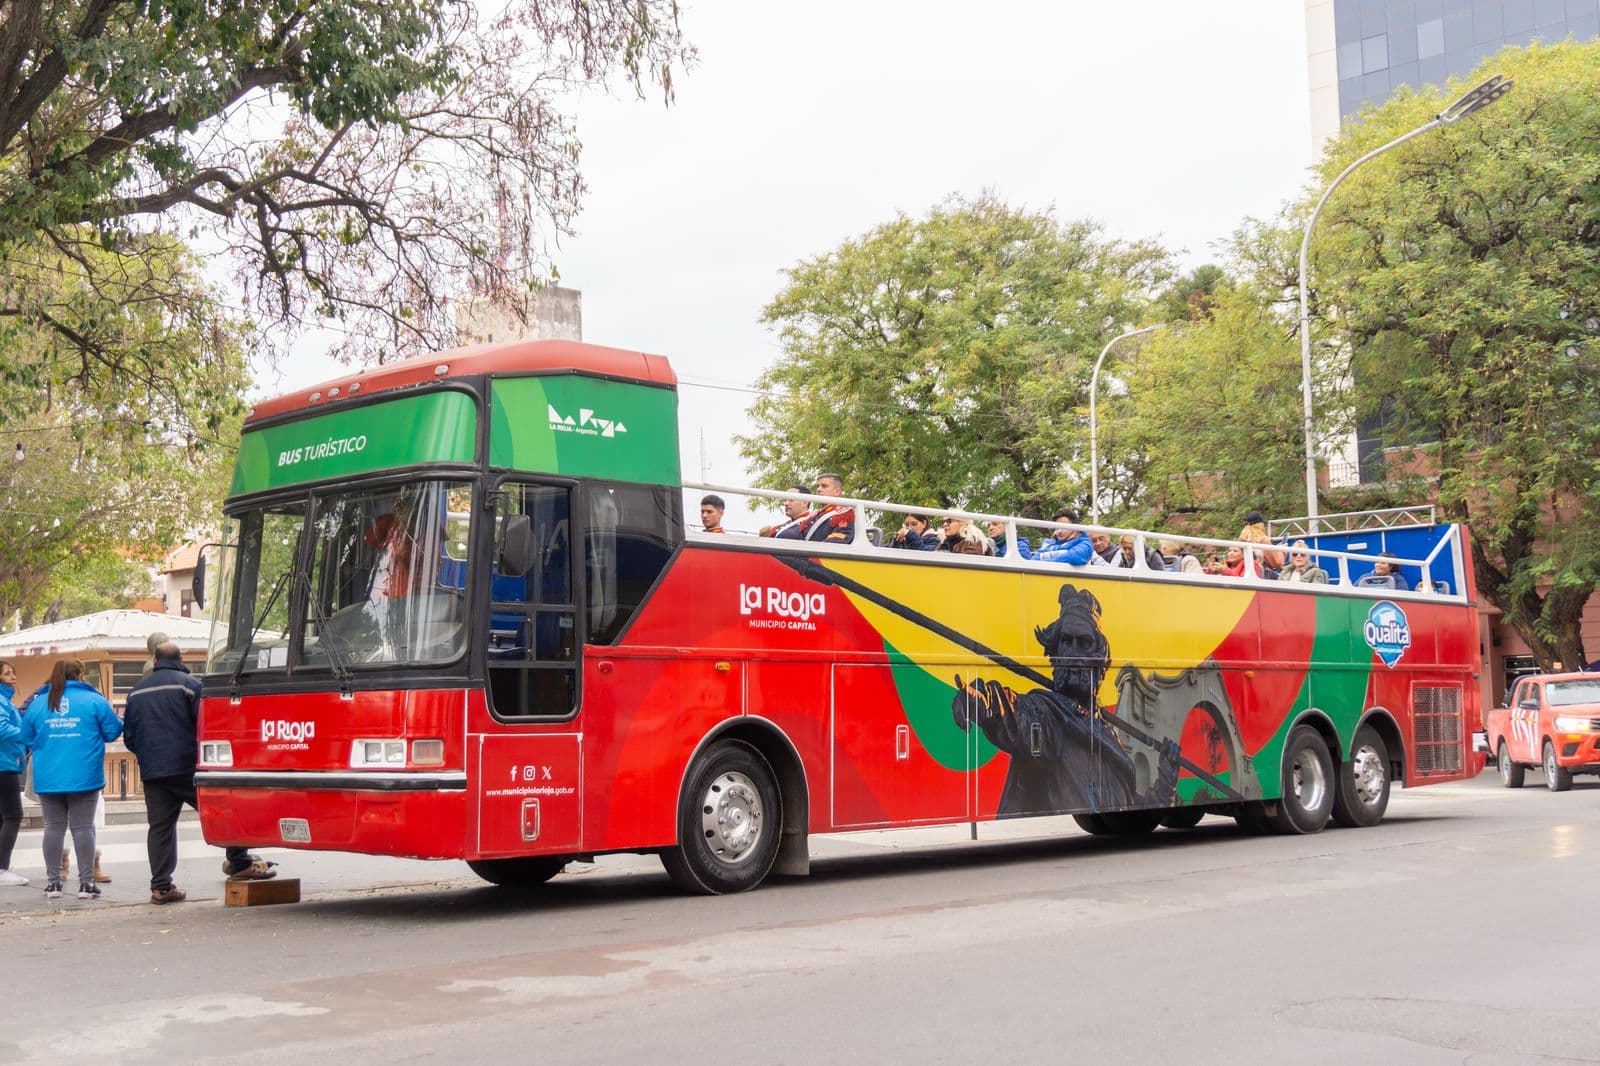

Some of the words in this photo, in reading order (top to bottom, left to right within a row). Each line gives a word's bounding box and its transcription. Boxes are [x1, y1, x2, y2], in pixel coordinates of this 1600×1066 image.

[278, 447, 302, 467] BUS
[304, 435, 367, 461] TURÍSTICO
[749, 619, 787, 630] MUNICIPIO
[787, 620, 817, 631] CAPITAL
